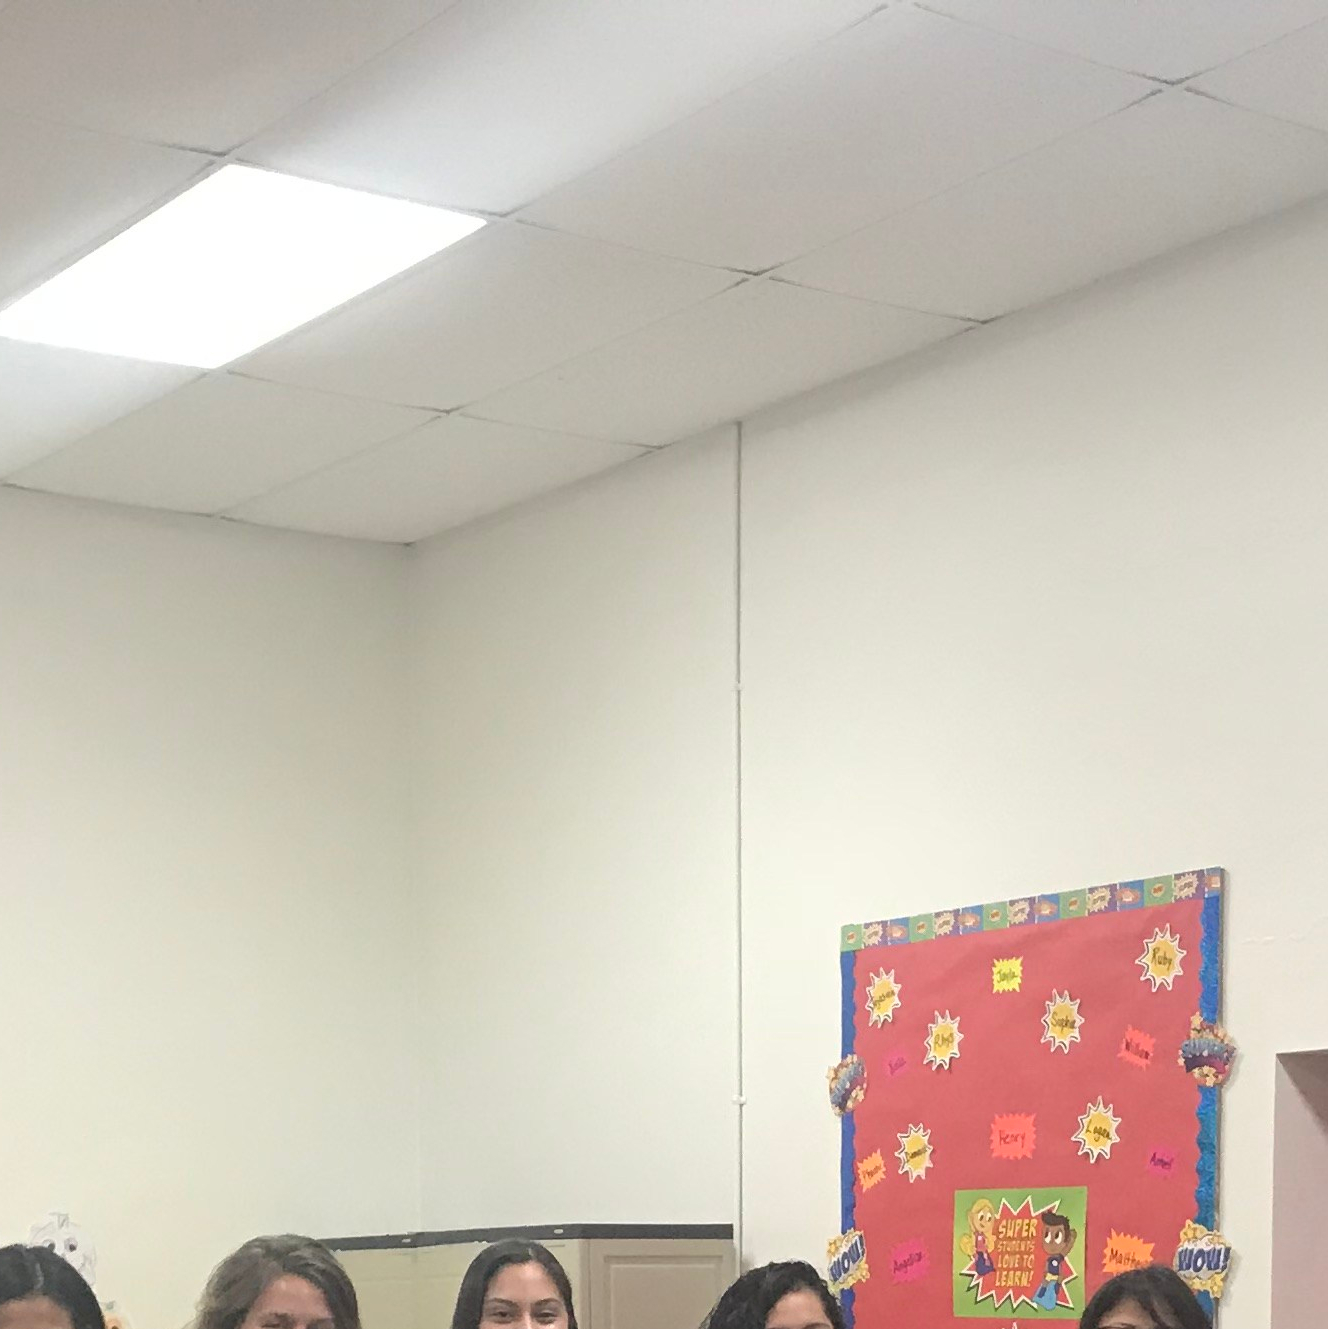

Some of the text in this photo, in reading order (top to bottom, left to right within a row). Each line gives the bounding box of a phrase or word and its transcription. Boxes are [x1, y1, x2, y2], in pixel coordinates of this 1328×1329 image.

[998, 1219, 1038, 1238] SUPER
[997, 1254, 1035, 1269] LOVE TO
[1177, 1246, 1231, 1273] WOW!
[995, 1271, 1034, 1288] LEARN!
